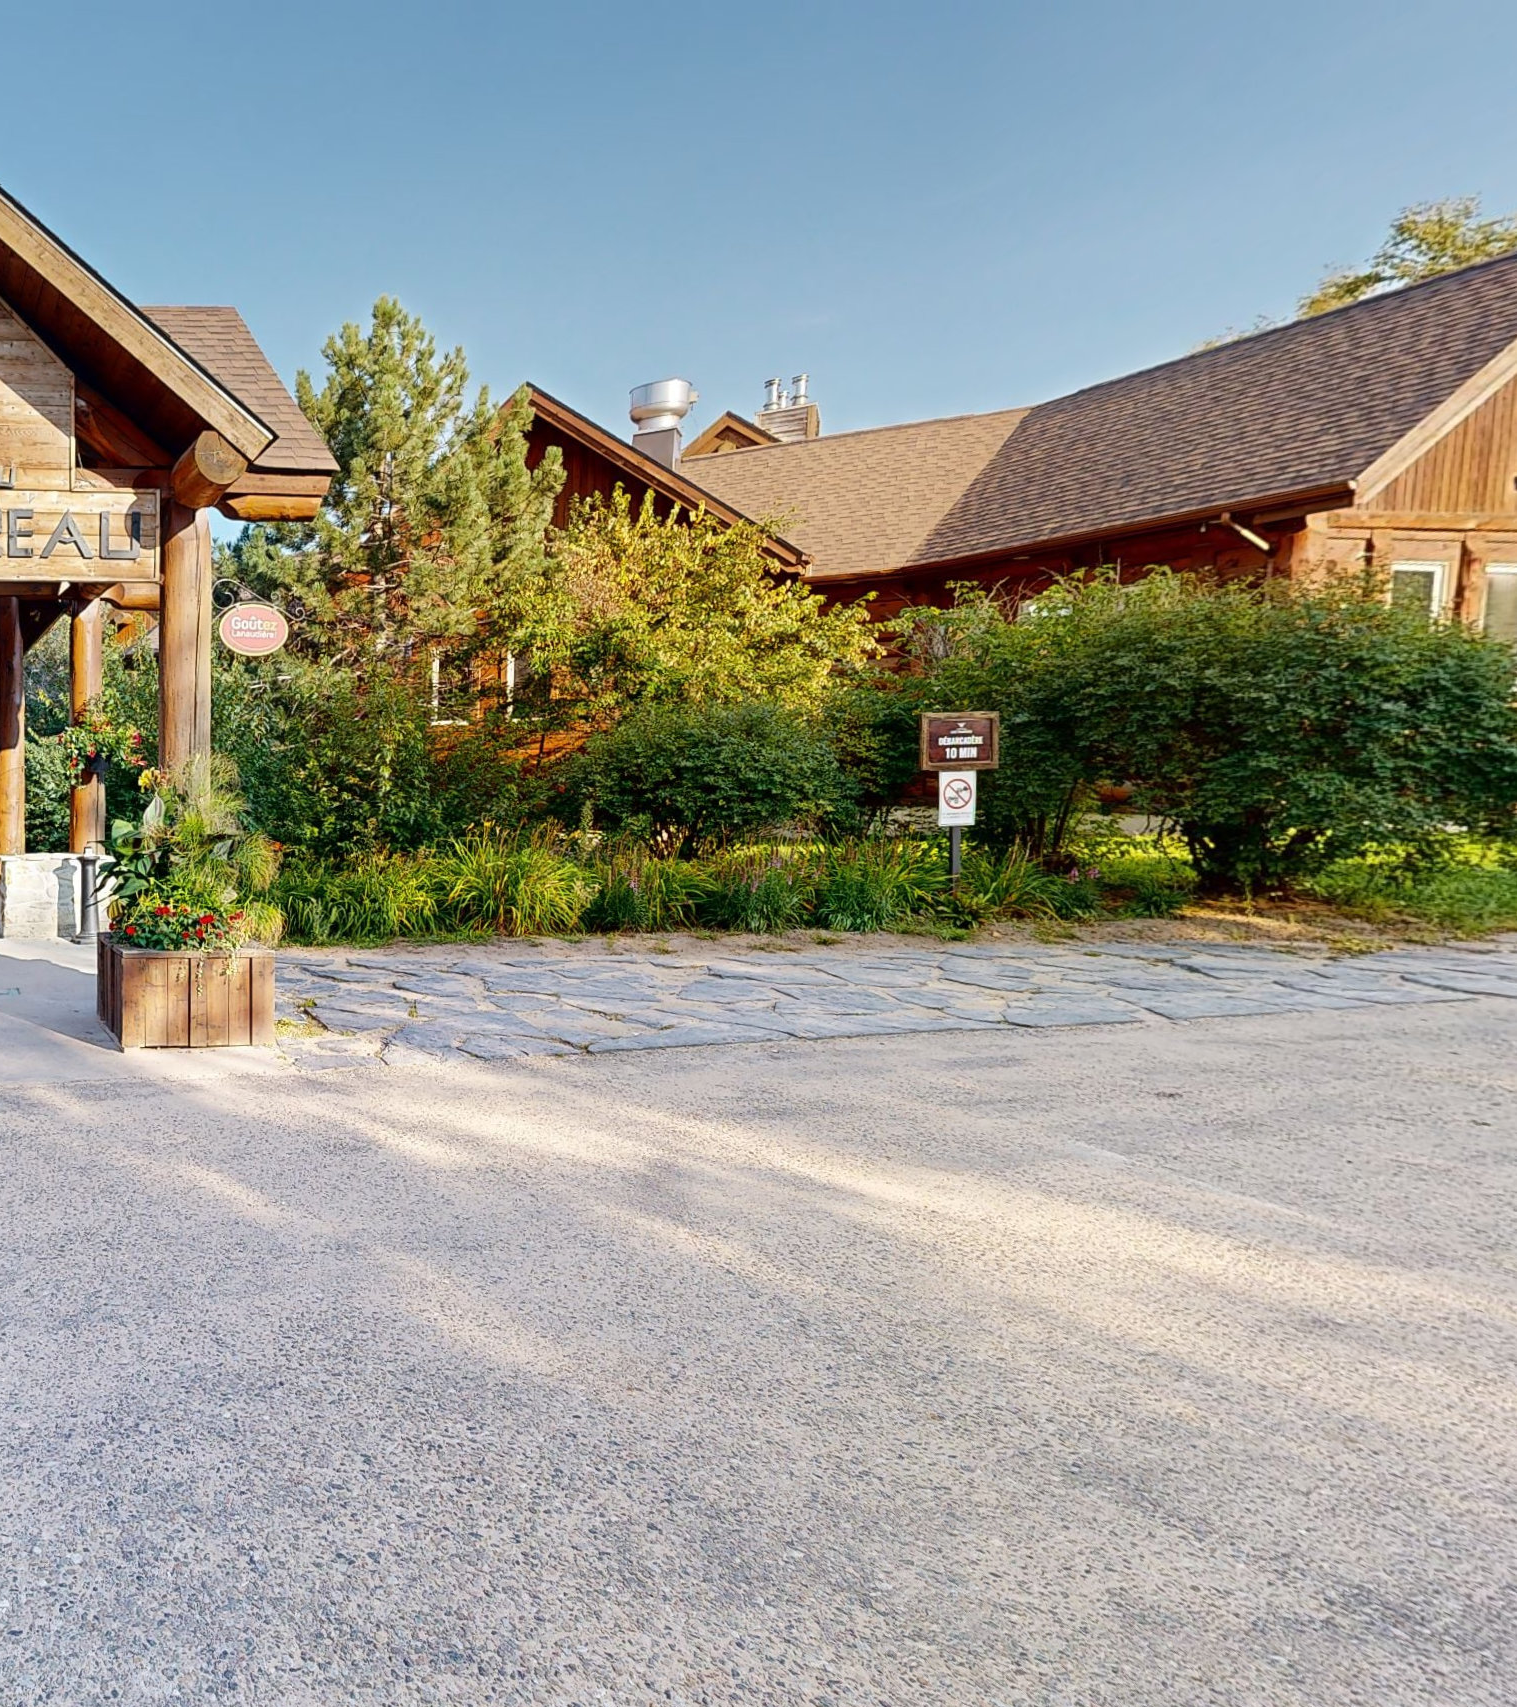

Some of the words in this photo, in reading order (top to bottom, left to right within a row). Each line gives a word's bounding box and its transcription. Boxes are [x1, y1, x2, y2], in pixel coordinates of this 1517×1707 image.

[231, 615, 278, 632] Goûtez
[945, 747, 957, 759] 10
[959, 746, 977, 758] MIN
